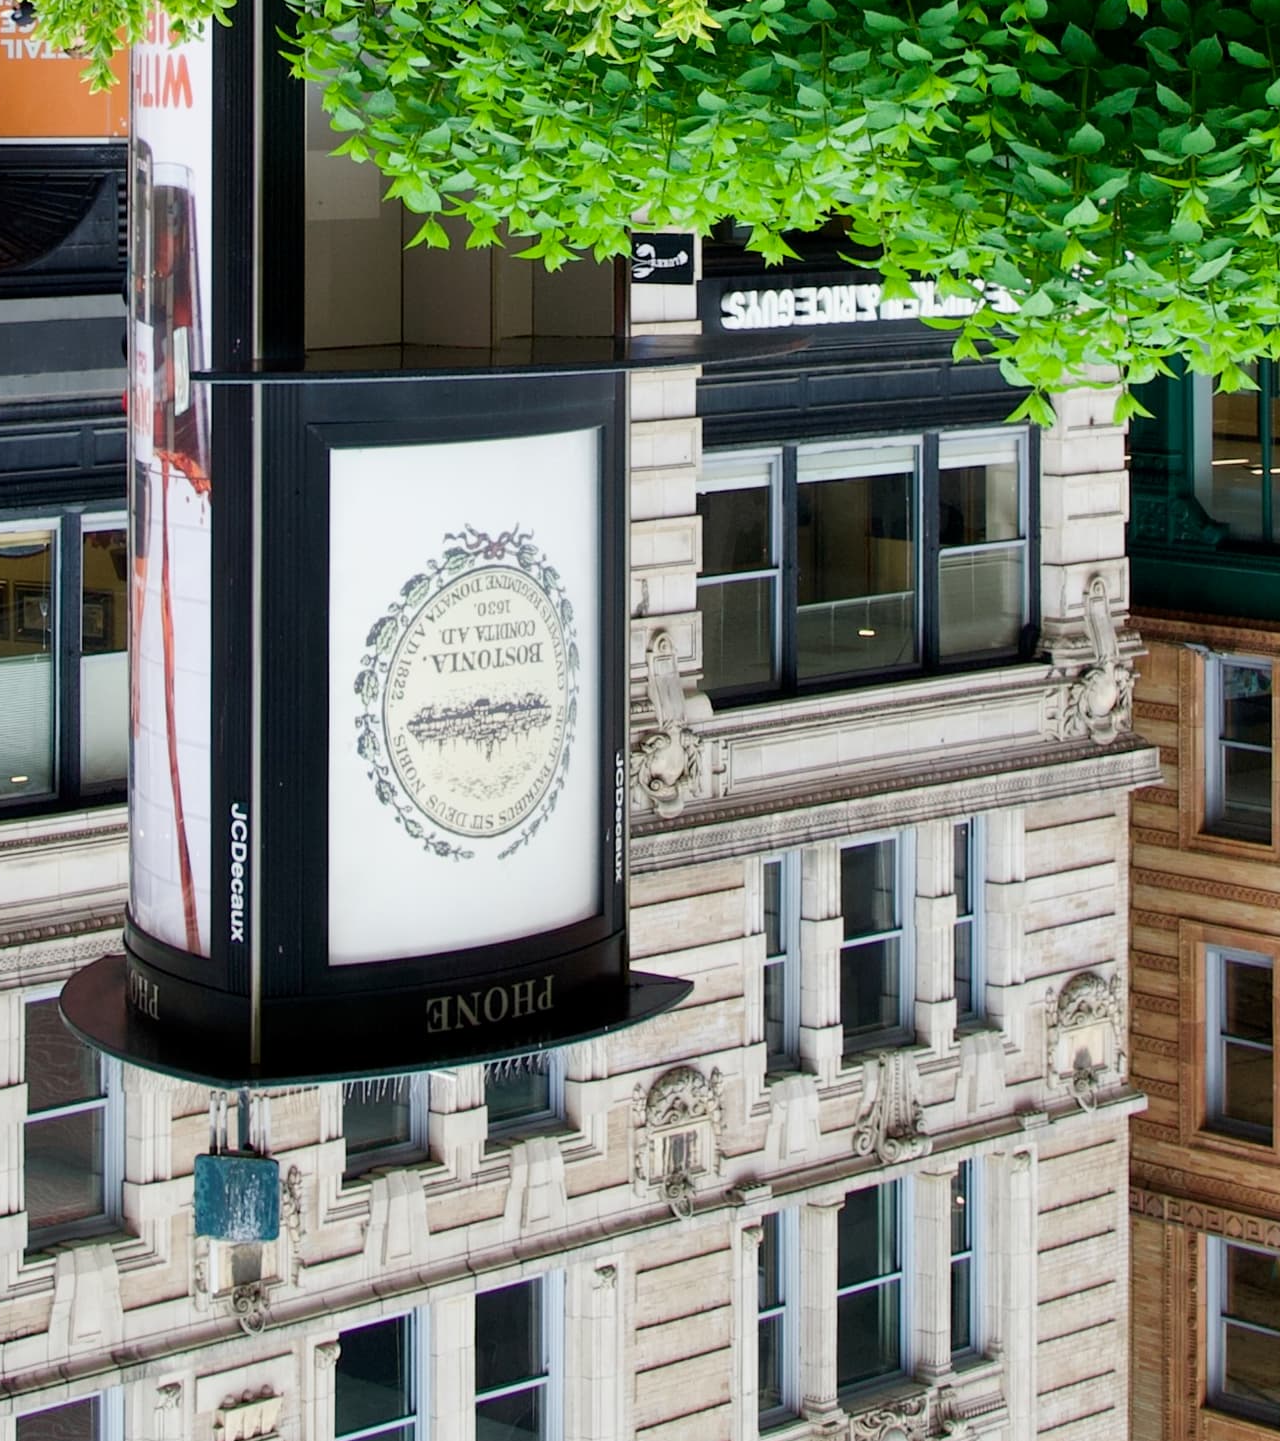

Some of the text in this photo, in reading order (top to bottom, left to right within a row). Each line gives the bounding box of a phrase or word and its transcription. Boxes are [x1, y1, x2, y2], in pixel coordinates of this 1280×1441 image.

[720, 289, 794, 330] GUYS
[424, 576, 484, 622] DONATA
[485, 574, 543, 610] REGIMINE
[475, 619, 536, 642] CONDITA
[425, 794, 467, 828] DEUS
[470, 814, 494, 831] SIT
[613, 750, 625, 882] JCDecaux
[229, 802, 249, 943] JCDecaux
[425, 974, 555, 1033] PHONE
